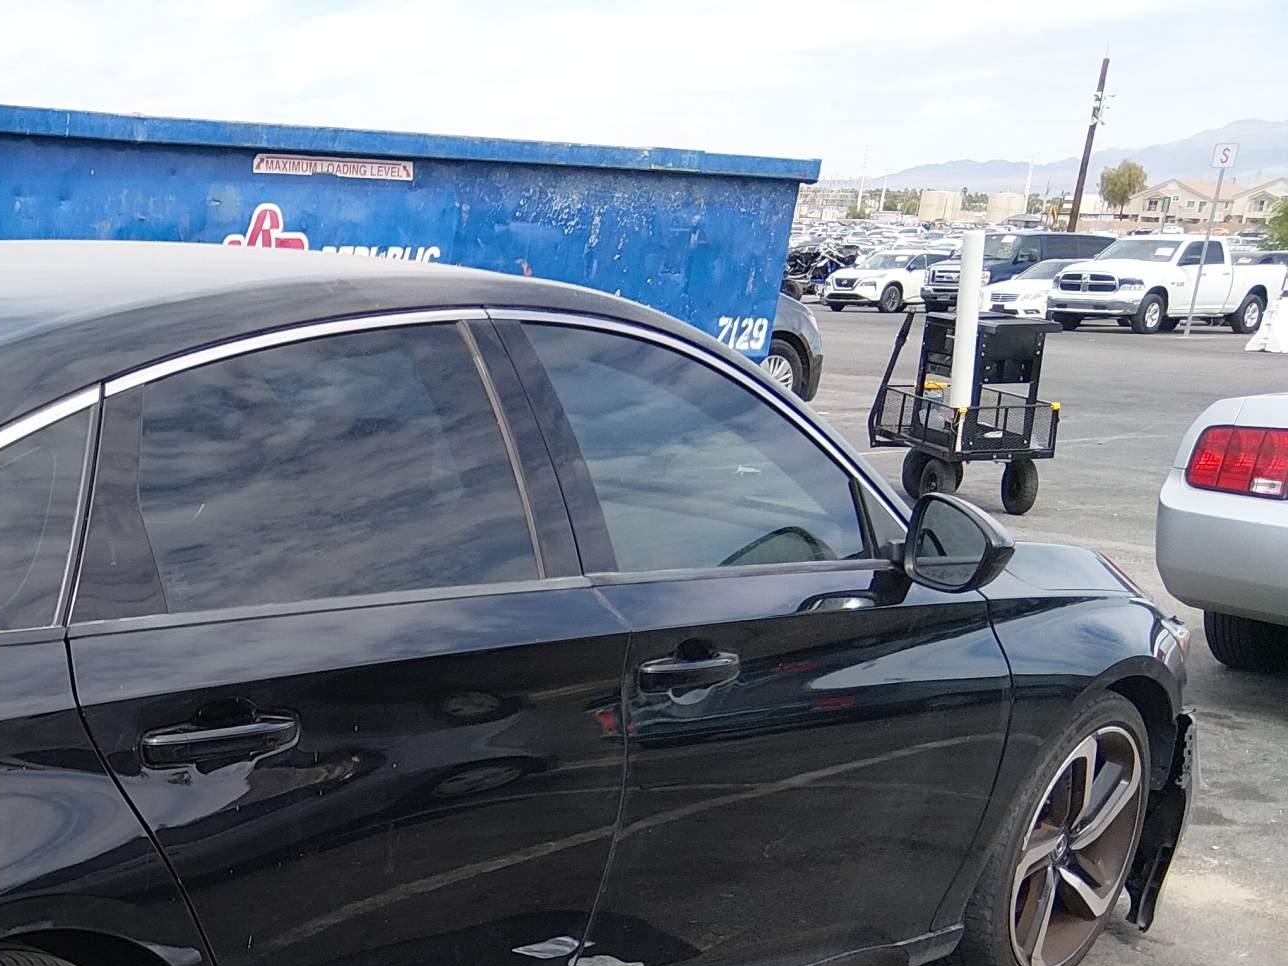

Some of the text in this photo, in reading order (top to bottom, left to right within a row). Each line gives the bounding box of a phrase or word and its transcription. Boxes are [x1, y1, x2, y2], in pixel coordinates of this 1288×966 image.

[1220, 147, 1231, 164] S
[265, 159, 403, 178] MAXIMUM LOADING LEVEL
[717, 315, 768, 350] 7129
